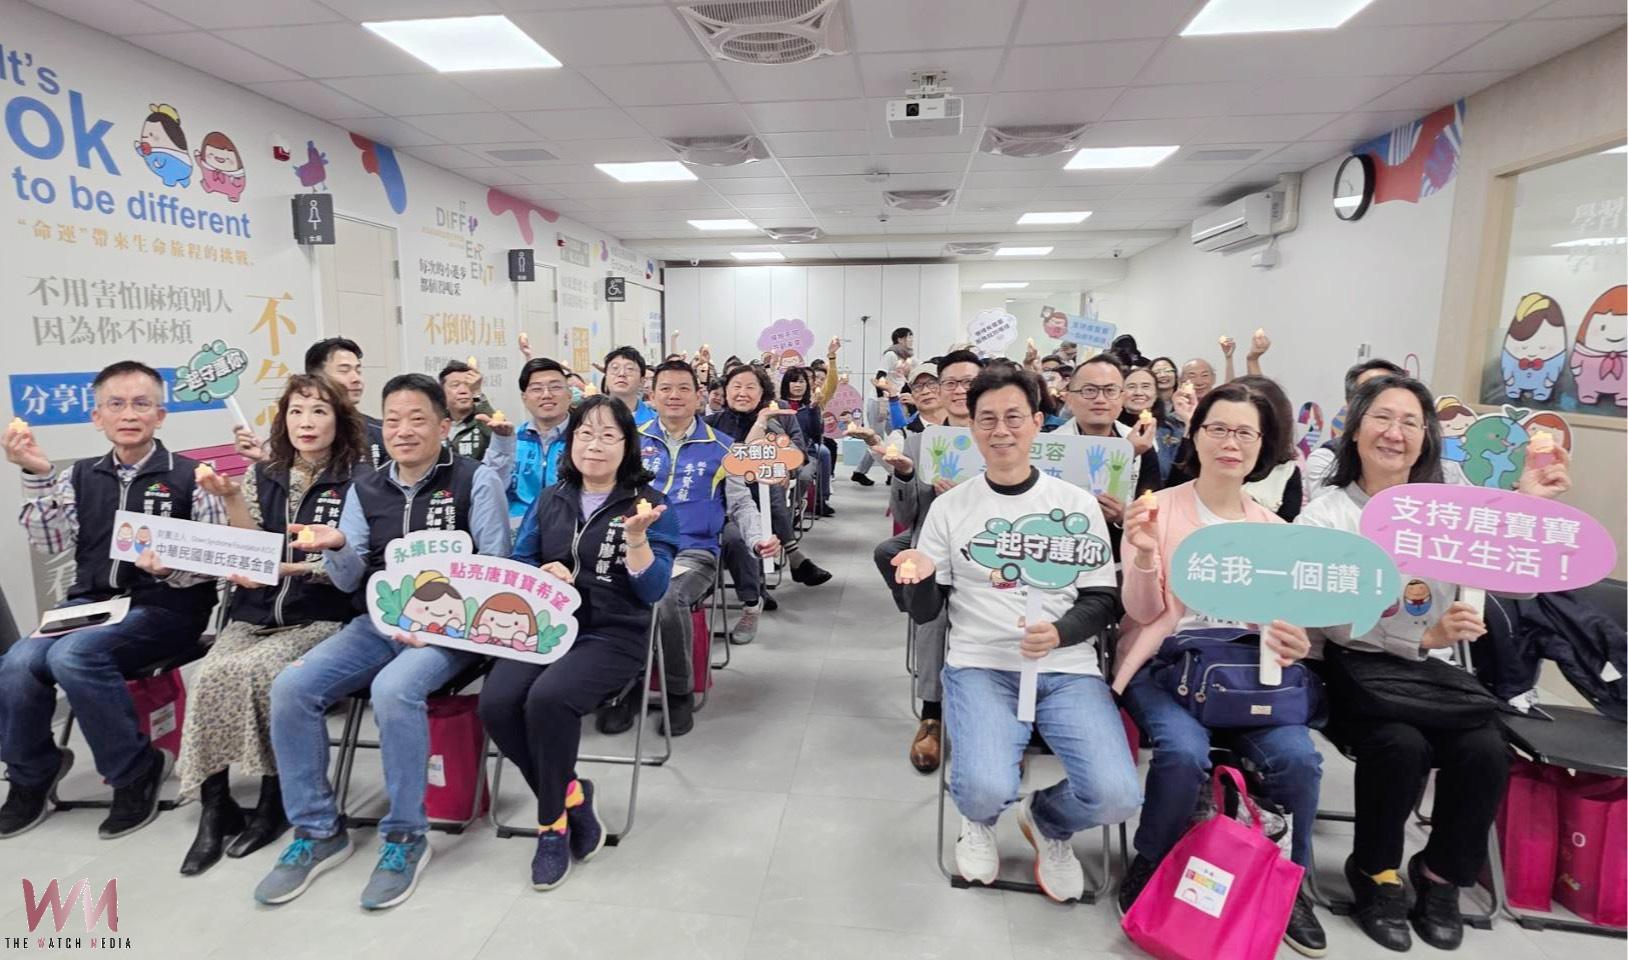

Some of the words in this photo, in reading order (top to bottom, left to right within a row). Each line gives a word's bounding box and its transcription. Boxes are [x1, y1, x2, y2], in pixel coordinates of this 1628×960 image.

[12, 166, 56, 202] to
[70, 175, 116, 215] be
[127, 191, 252, 239] different
[25, 275, 233, 314] 不用害怕麻煩別人
[32, 315, 194, 346] 因為你不麻煩
[173, 351, 247, 393] 一起守護你
[733, 444, 777, 461] 不倒的
[757, 463, 788, 479] 力量
[1390, 494, 1582, 550] 支持唐寶寶
[155, 543, 276, 575] 中華民國唐氏症基金會
[393, 539, 463, 563] 永續ESG
[969, 530, 1104, 567] 一起守護你
[1393, 529, 1570, 582] 自立生活！
[450, 561, 570, 612] 點亮唐寶寶希望
[1186, 552, 1385, 596] 給我一個讚！
